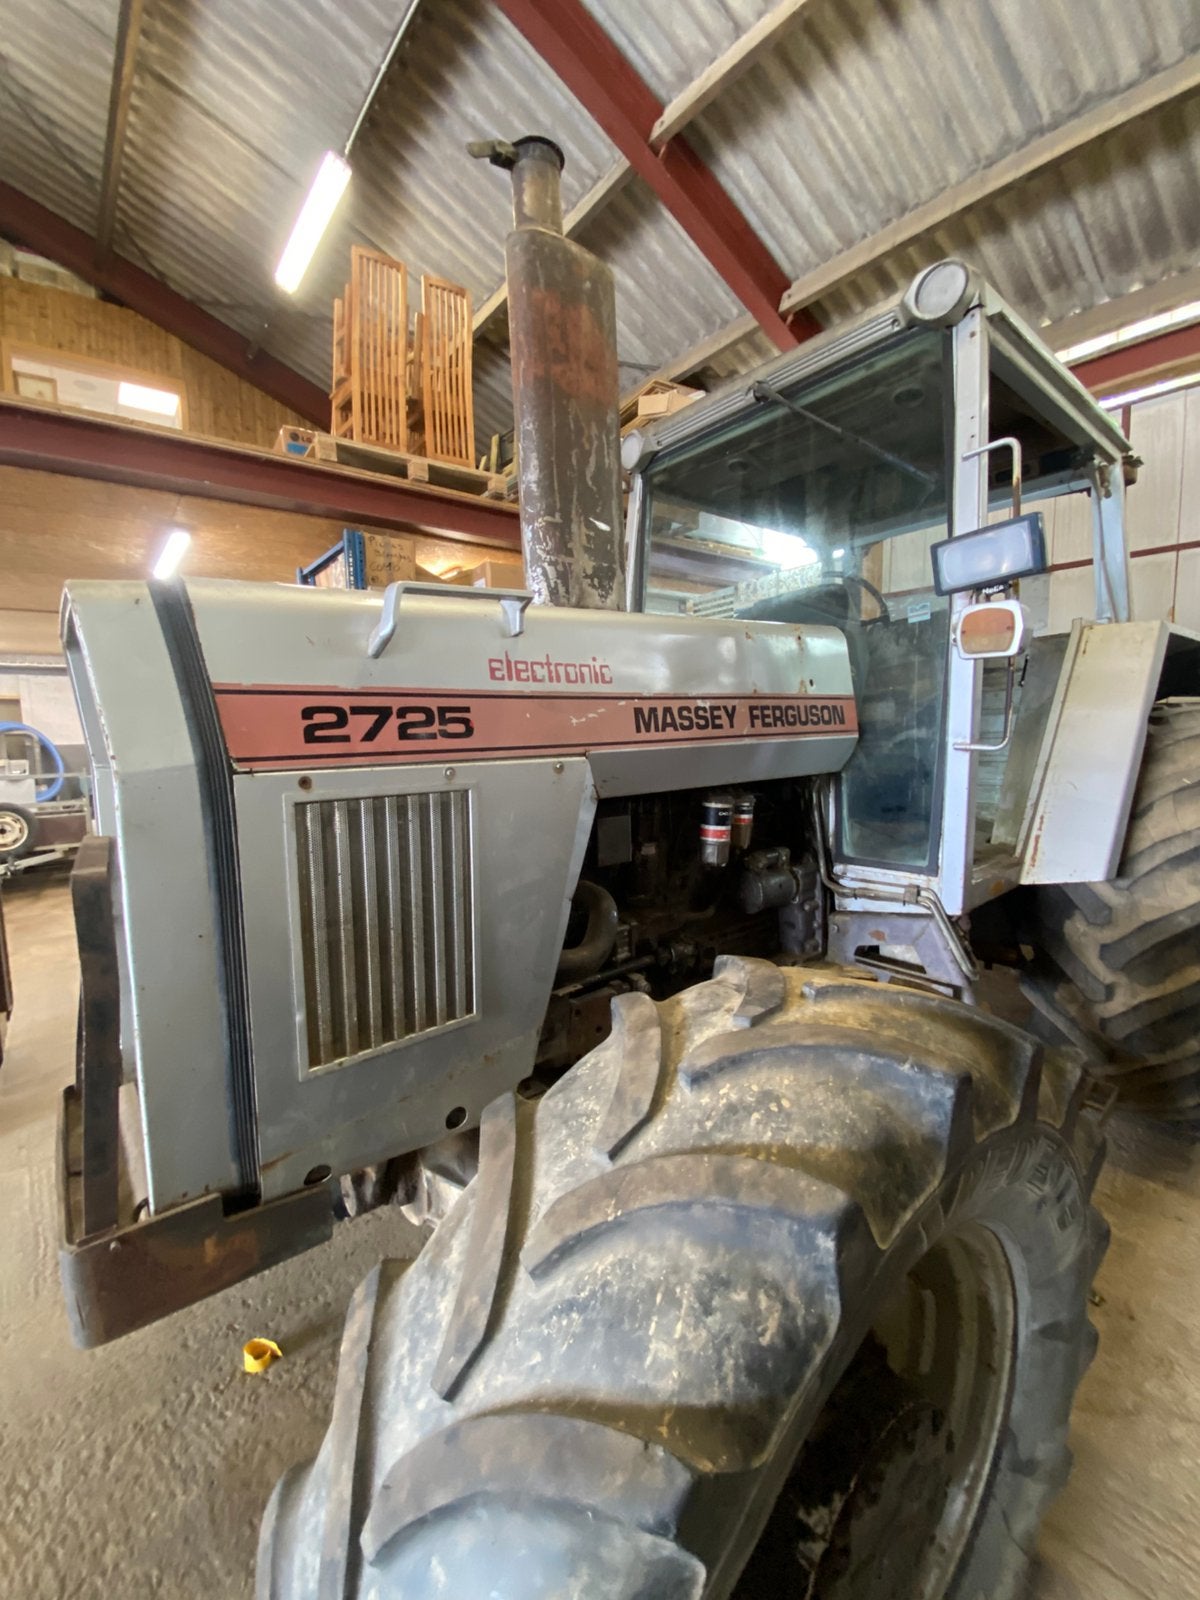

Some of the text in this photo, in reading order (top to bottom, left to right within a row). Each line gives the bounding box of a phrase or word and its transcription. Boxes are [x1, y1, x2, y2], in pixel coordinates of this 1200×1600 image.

[488, 650, 613, 685] electronic
[301, 706, 474, 743] 2725
[634, 704, 845, 733] MASSEY FERGUSON
